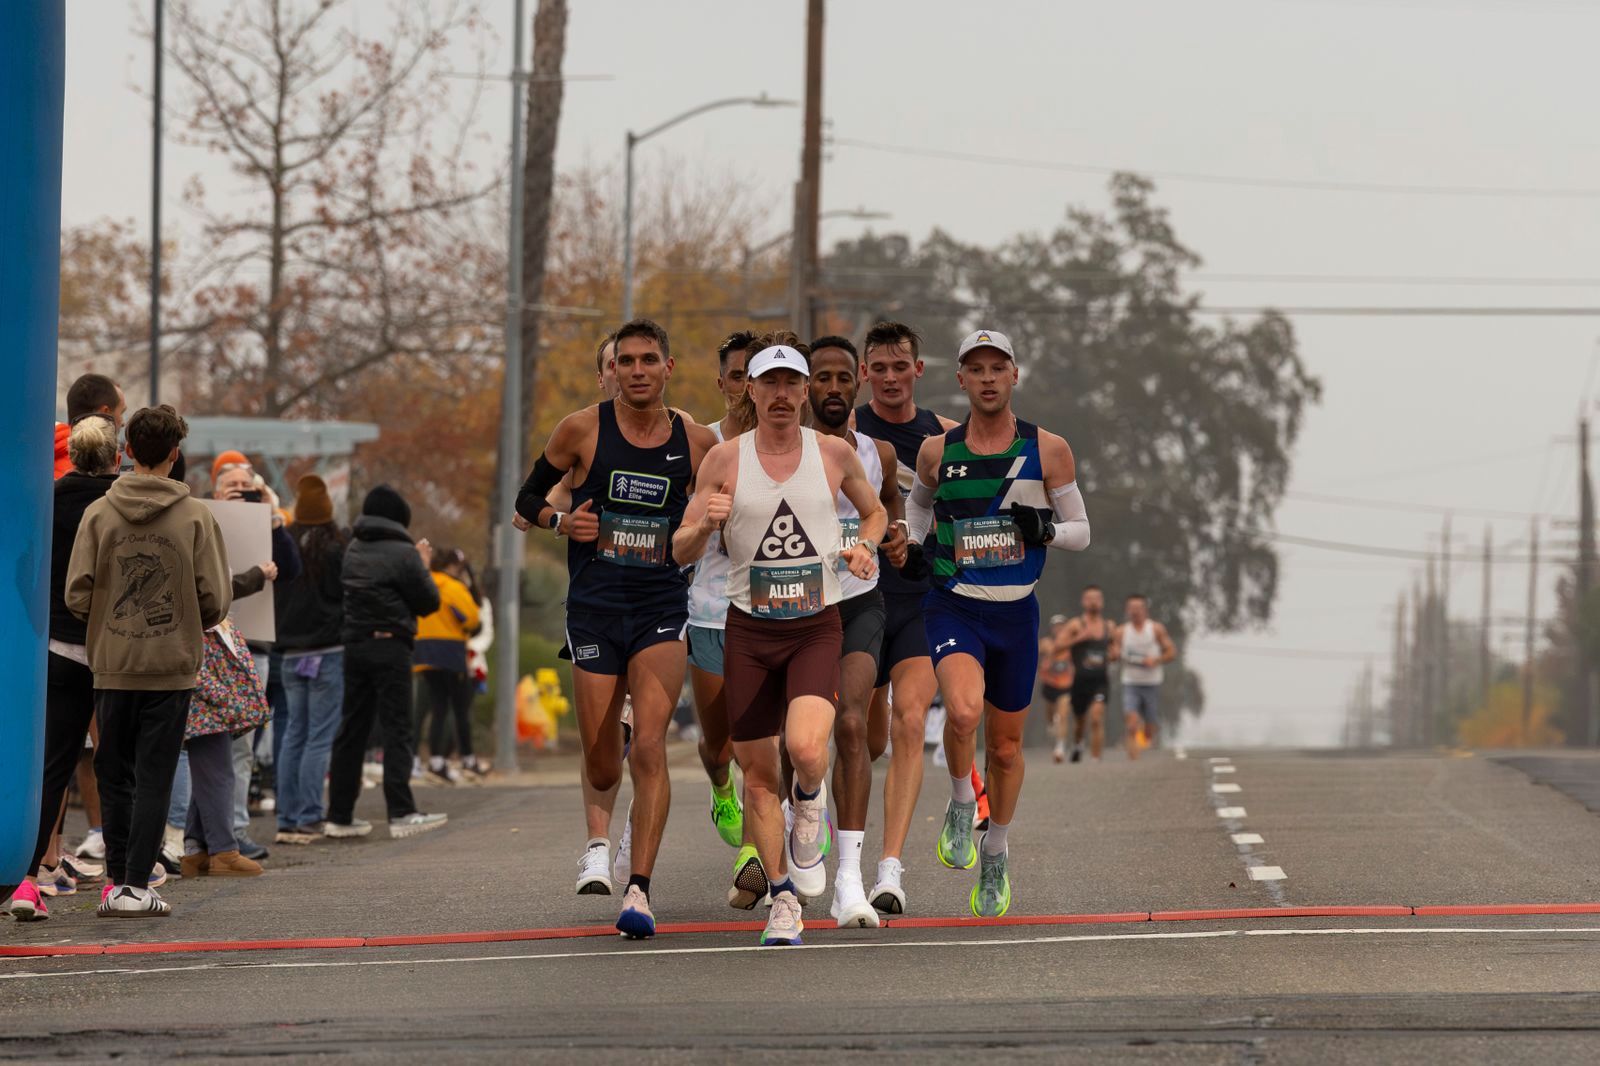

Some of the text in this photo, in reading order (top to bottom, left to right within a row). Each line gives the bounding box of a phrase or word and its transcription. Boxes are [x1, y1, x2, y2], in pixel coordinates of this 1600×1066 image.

[629, 486, 658, 496] Distance
[630, 479, 664, 490] Minnesota
[612, 530, 656, 548] TROJAN
[962, 532, 1015, 550] THOMSON
[769, 582, 804, 598] ALLEN
